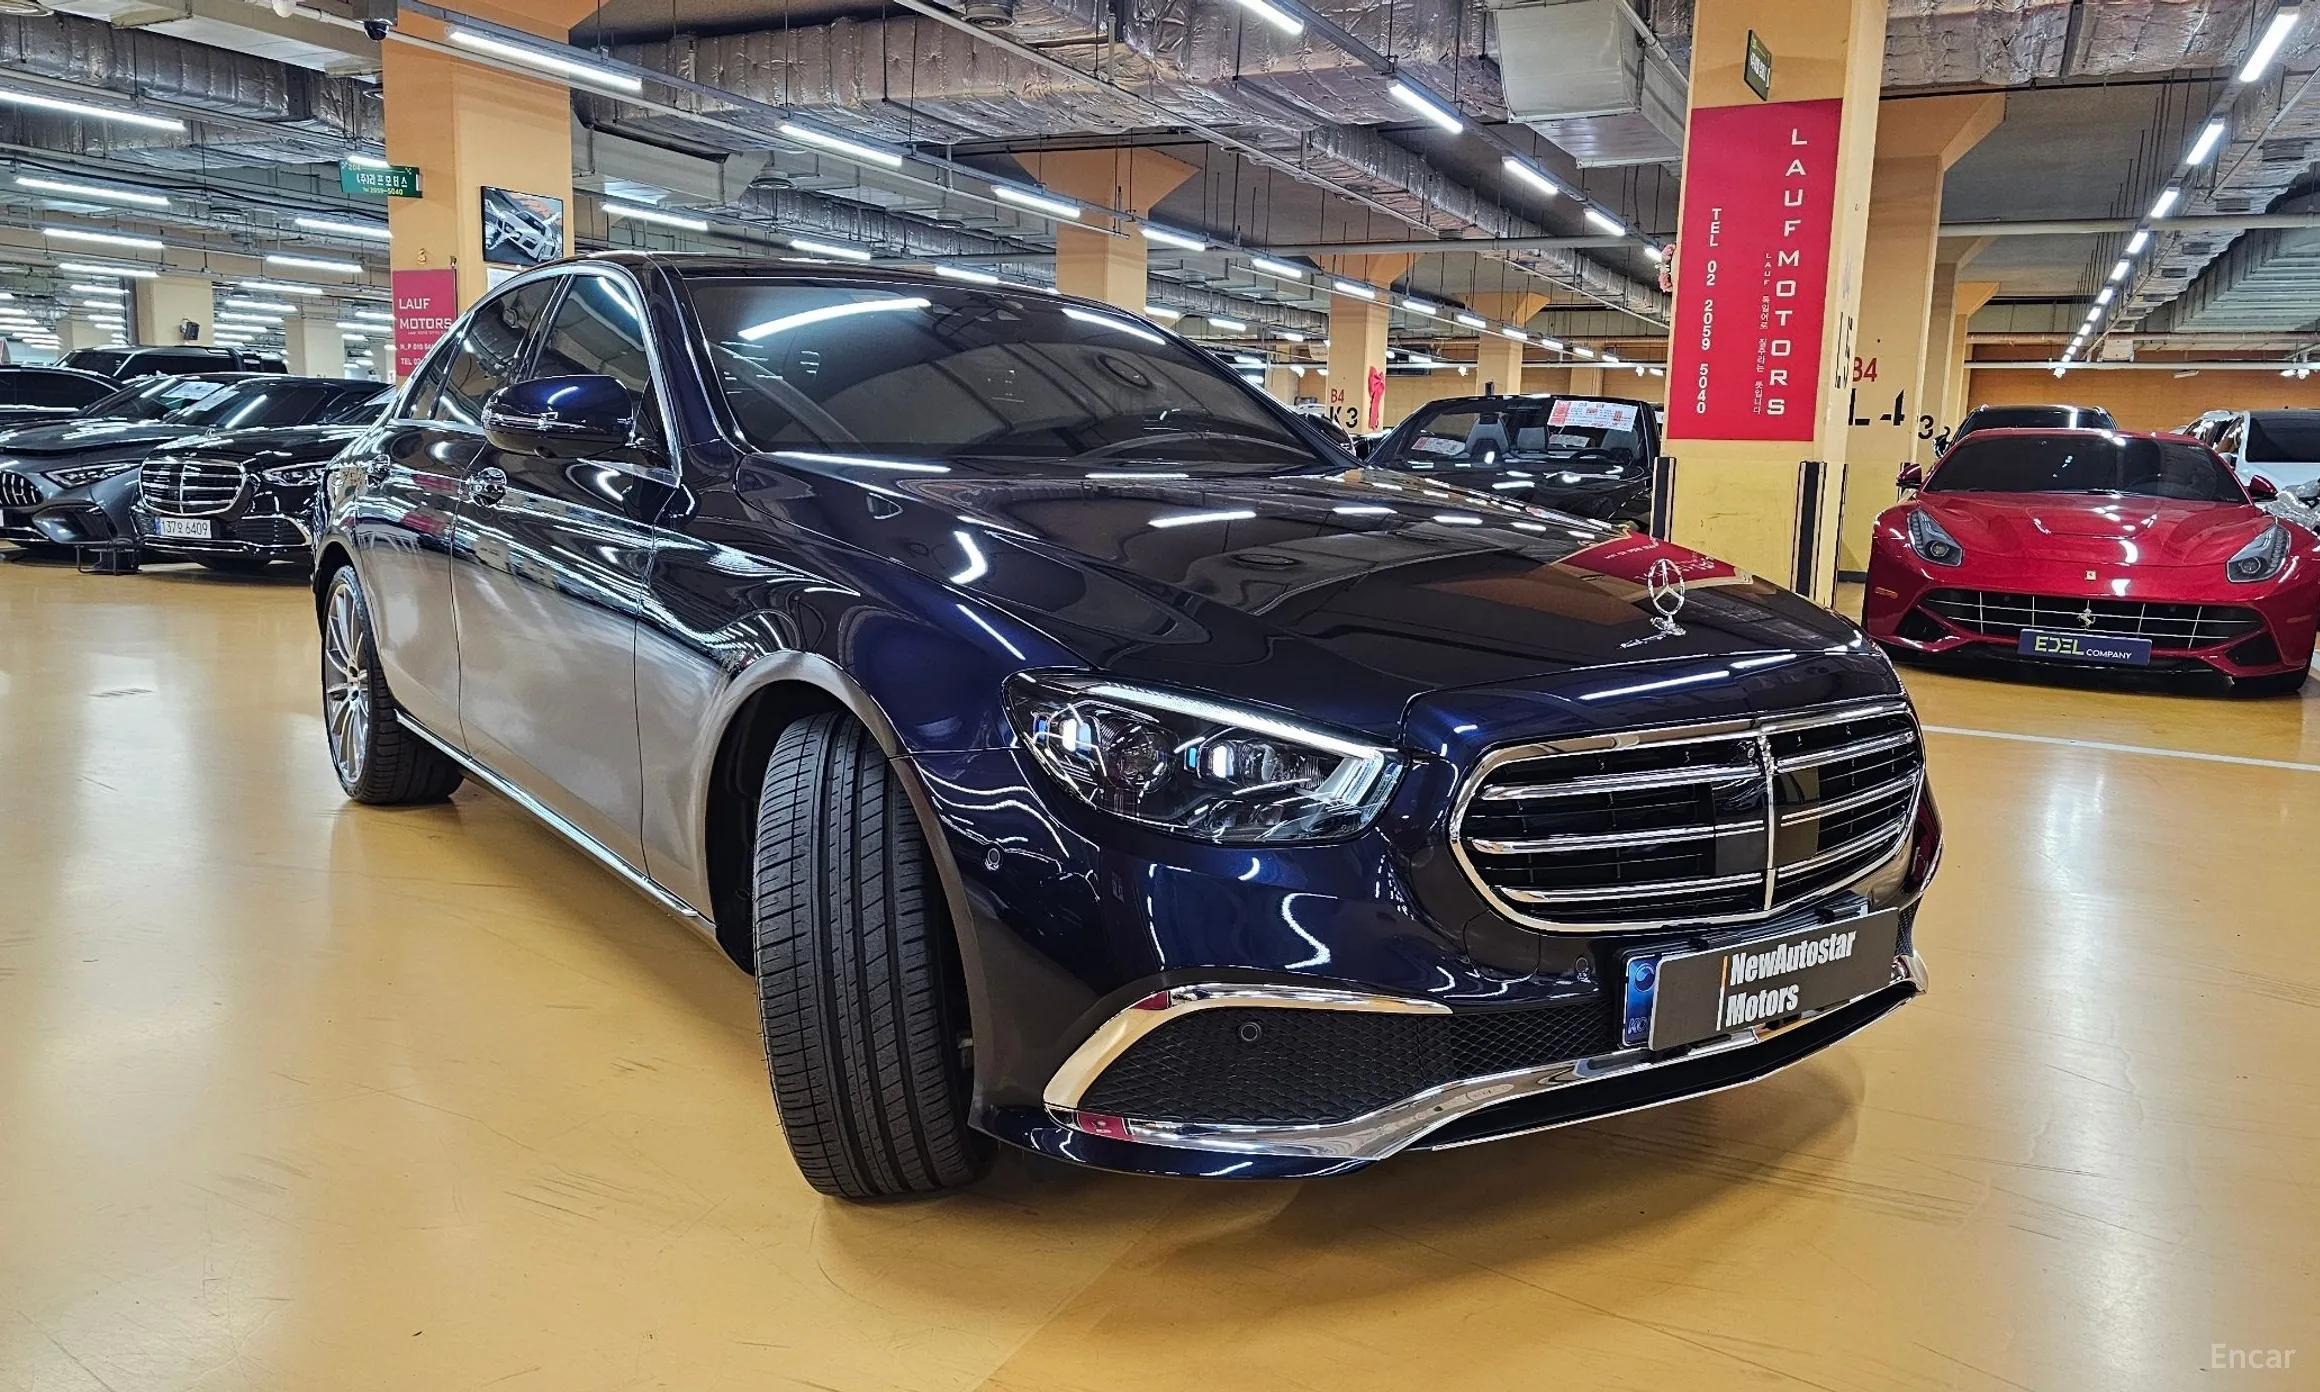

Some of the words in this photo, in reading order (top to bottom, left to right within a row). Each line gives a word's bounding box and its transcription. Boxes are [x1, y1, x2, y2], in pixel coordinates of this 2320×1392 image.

[1709, 208, 1722, 247] TEL
[1706, 260, 1717, 286] 02
[1763, 253, 1771, 286] LAUF
[399, 298, 430, 310] LAUF
[400, 318, 452, 329] MOTORS
[1701, 299, 1713, 351] 2059
[401, 357, 413, 366] TEL
[1852, 356, 1878, 382] B4
[1331, 388, 1345, 403] B4
[1696, 363, 1709, 414] 5040
[185, 522, 208, 536] 6409
[2034, 636, 2084, 656] EDEL
[2086, 649, 2132, 660] COMPANY
[1730, 930, 1857, 987] NewAutostar
[1726, 984, 1800, 1027] Motors
[1627, 1016, 1650, 1035] KO
